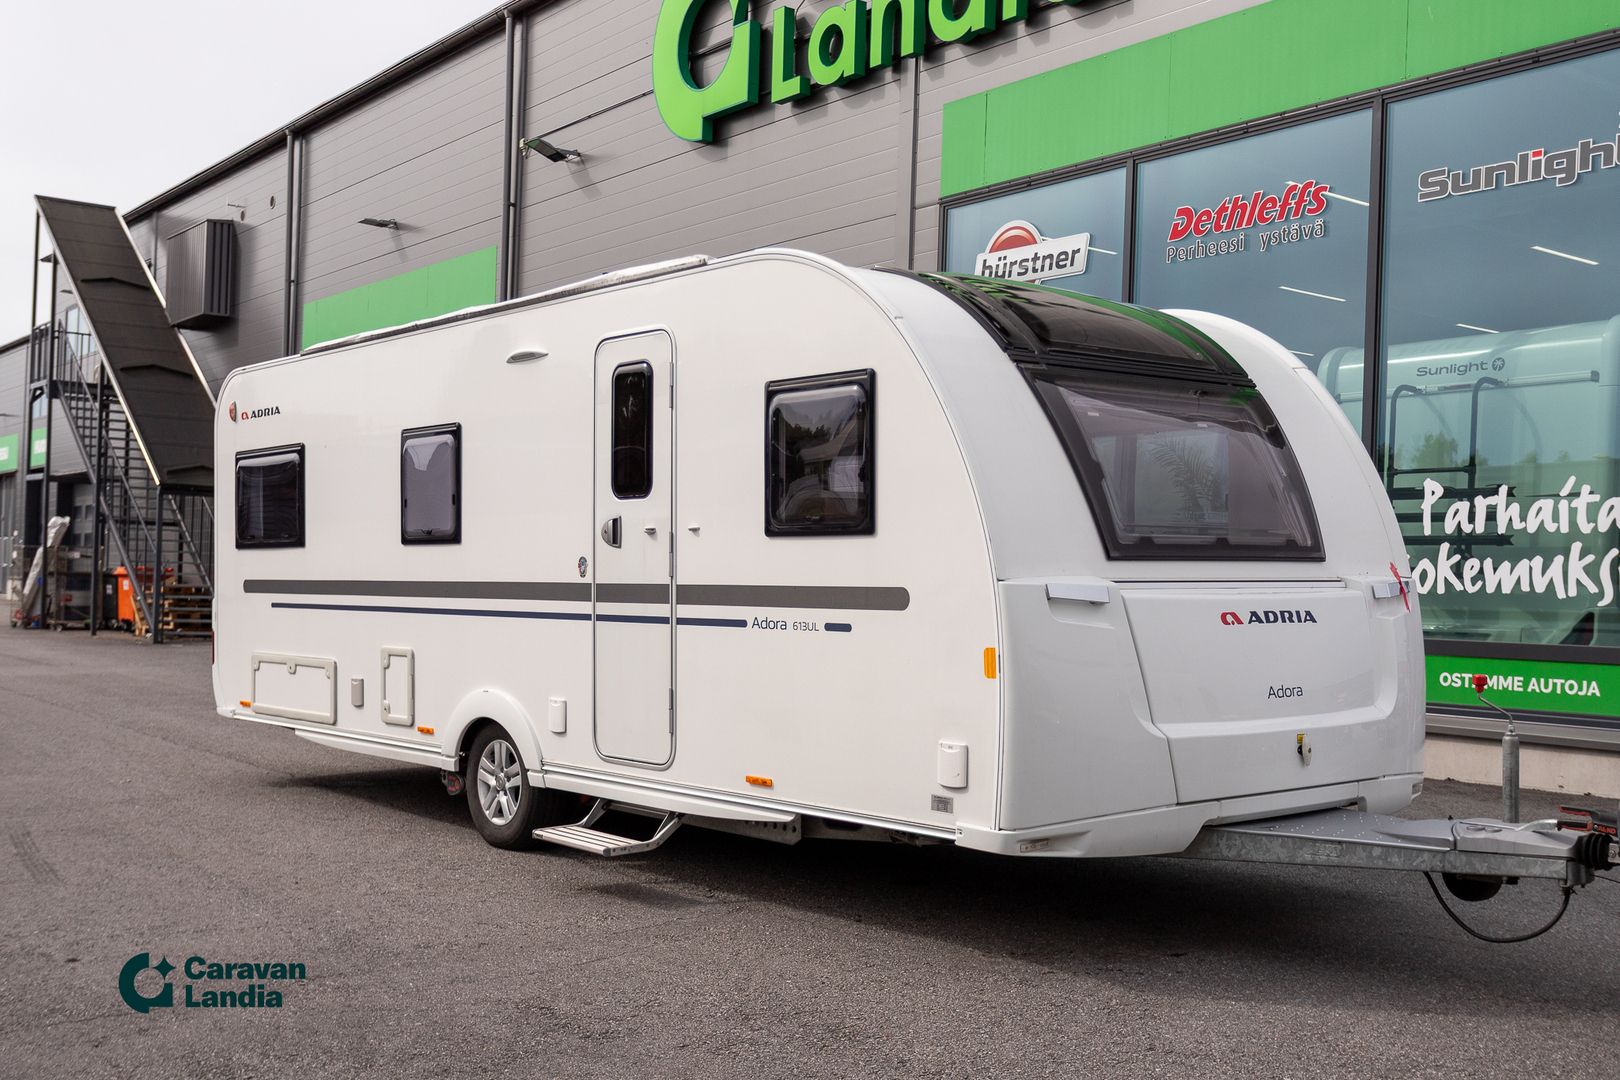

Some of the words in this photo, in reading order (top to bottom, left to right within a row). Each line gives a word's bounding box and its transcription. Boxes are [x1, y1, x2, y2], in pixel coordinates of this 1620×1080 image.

[771, 0, 1066, 104] Lan
[1418, 133, 1620, 202] Sunligh
[1168, 180, 1330, 242] Dethleffs
[1166, 232, 1245, 263] Perheesi
[1260, 219, 1325, 251] ystävä
[1416, 361, 1488, 377] Sunlight
[250, 406, 281, 419] ADRIA
[1407, 541, 1620, 607] okemuks
[751, 616, 788, 631] Adora
[792, 621, 820, 632] 613UL
[1248, 610, 1318, 625] ADRIA
[1267, 684, 1304, 700] Adora
[1439, 672, 1523, 692] OSTMME
[1527, 677, 1600, 697] AUTOJA
